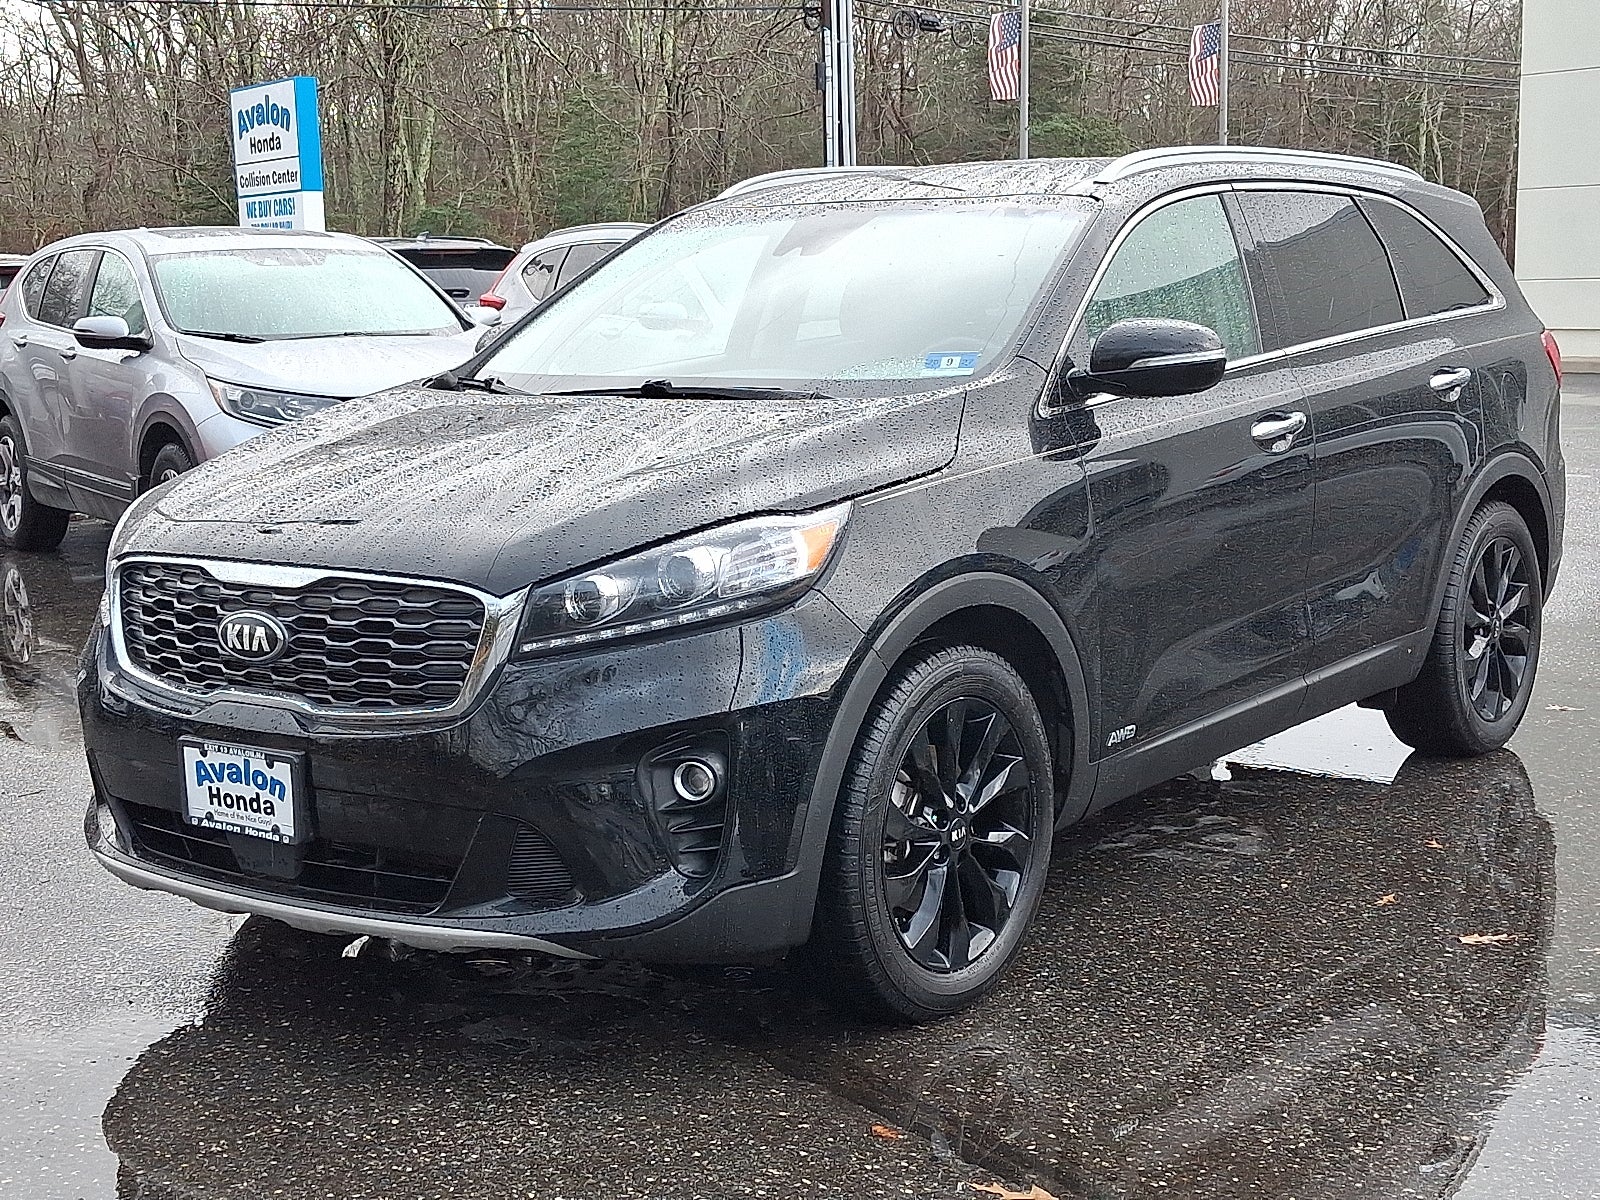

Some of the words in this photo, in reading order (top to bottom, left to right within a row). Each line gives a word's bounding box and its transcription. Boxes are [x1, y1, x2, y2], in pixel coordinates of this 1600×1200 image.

[237, 95, 291, 140] Avalon
[249, 132, 281, 155] Honda
[240, 170, 271, 188] Collision
[272, 169, 298, 185] Center
[246, 201, 257, 219] WE
[258, 200, 272, 218] BUY
[273, 197, 296, 216] CARS!
[946, 358, 954, 367] 9
[227, 622, 271, 652] KIA
[1106, 724, 1137, 747] AWD
[195, 759, 286, 802] Avalon
[207, 785, 276, 817] Honda
[201, 818, 241, 834] Avalon
[244, 826, 280, 842] Honda
[951, 826, 966, 842] KIA
